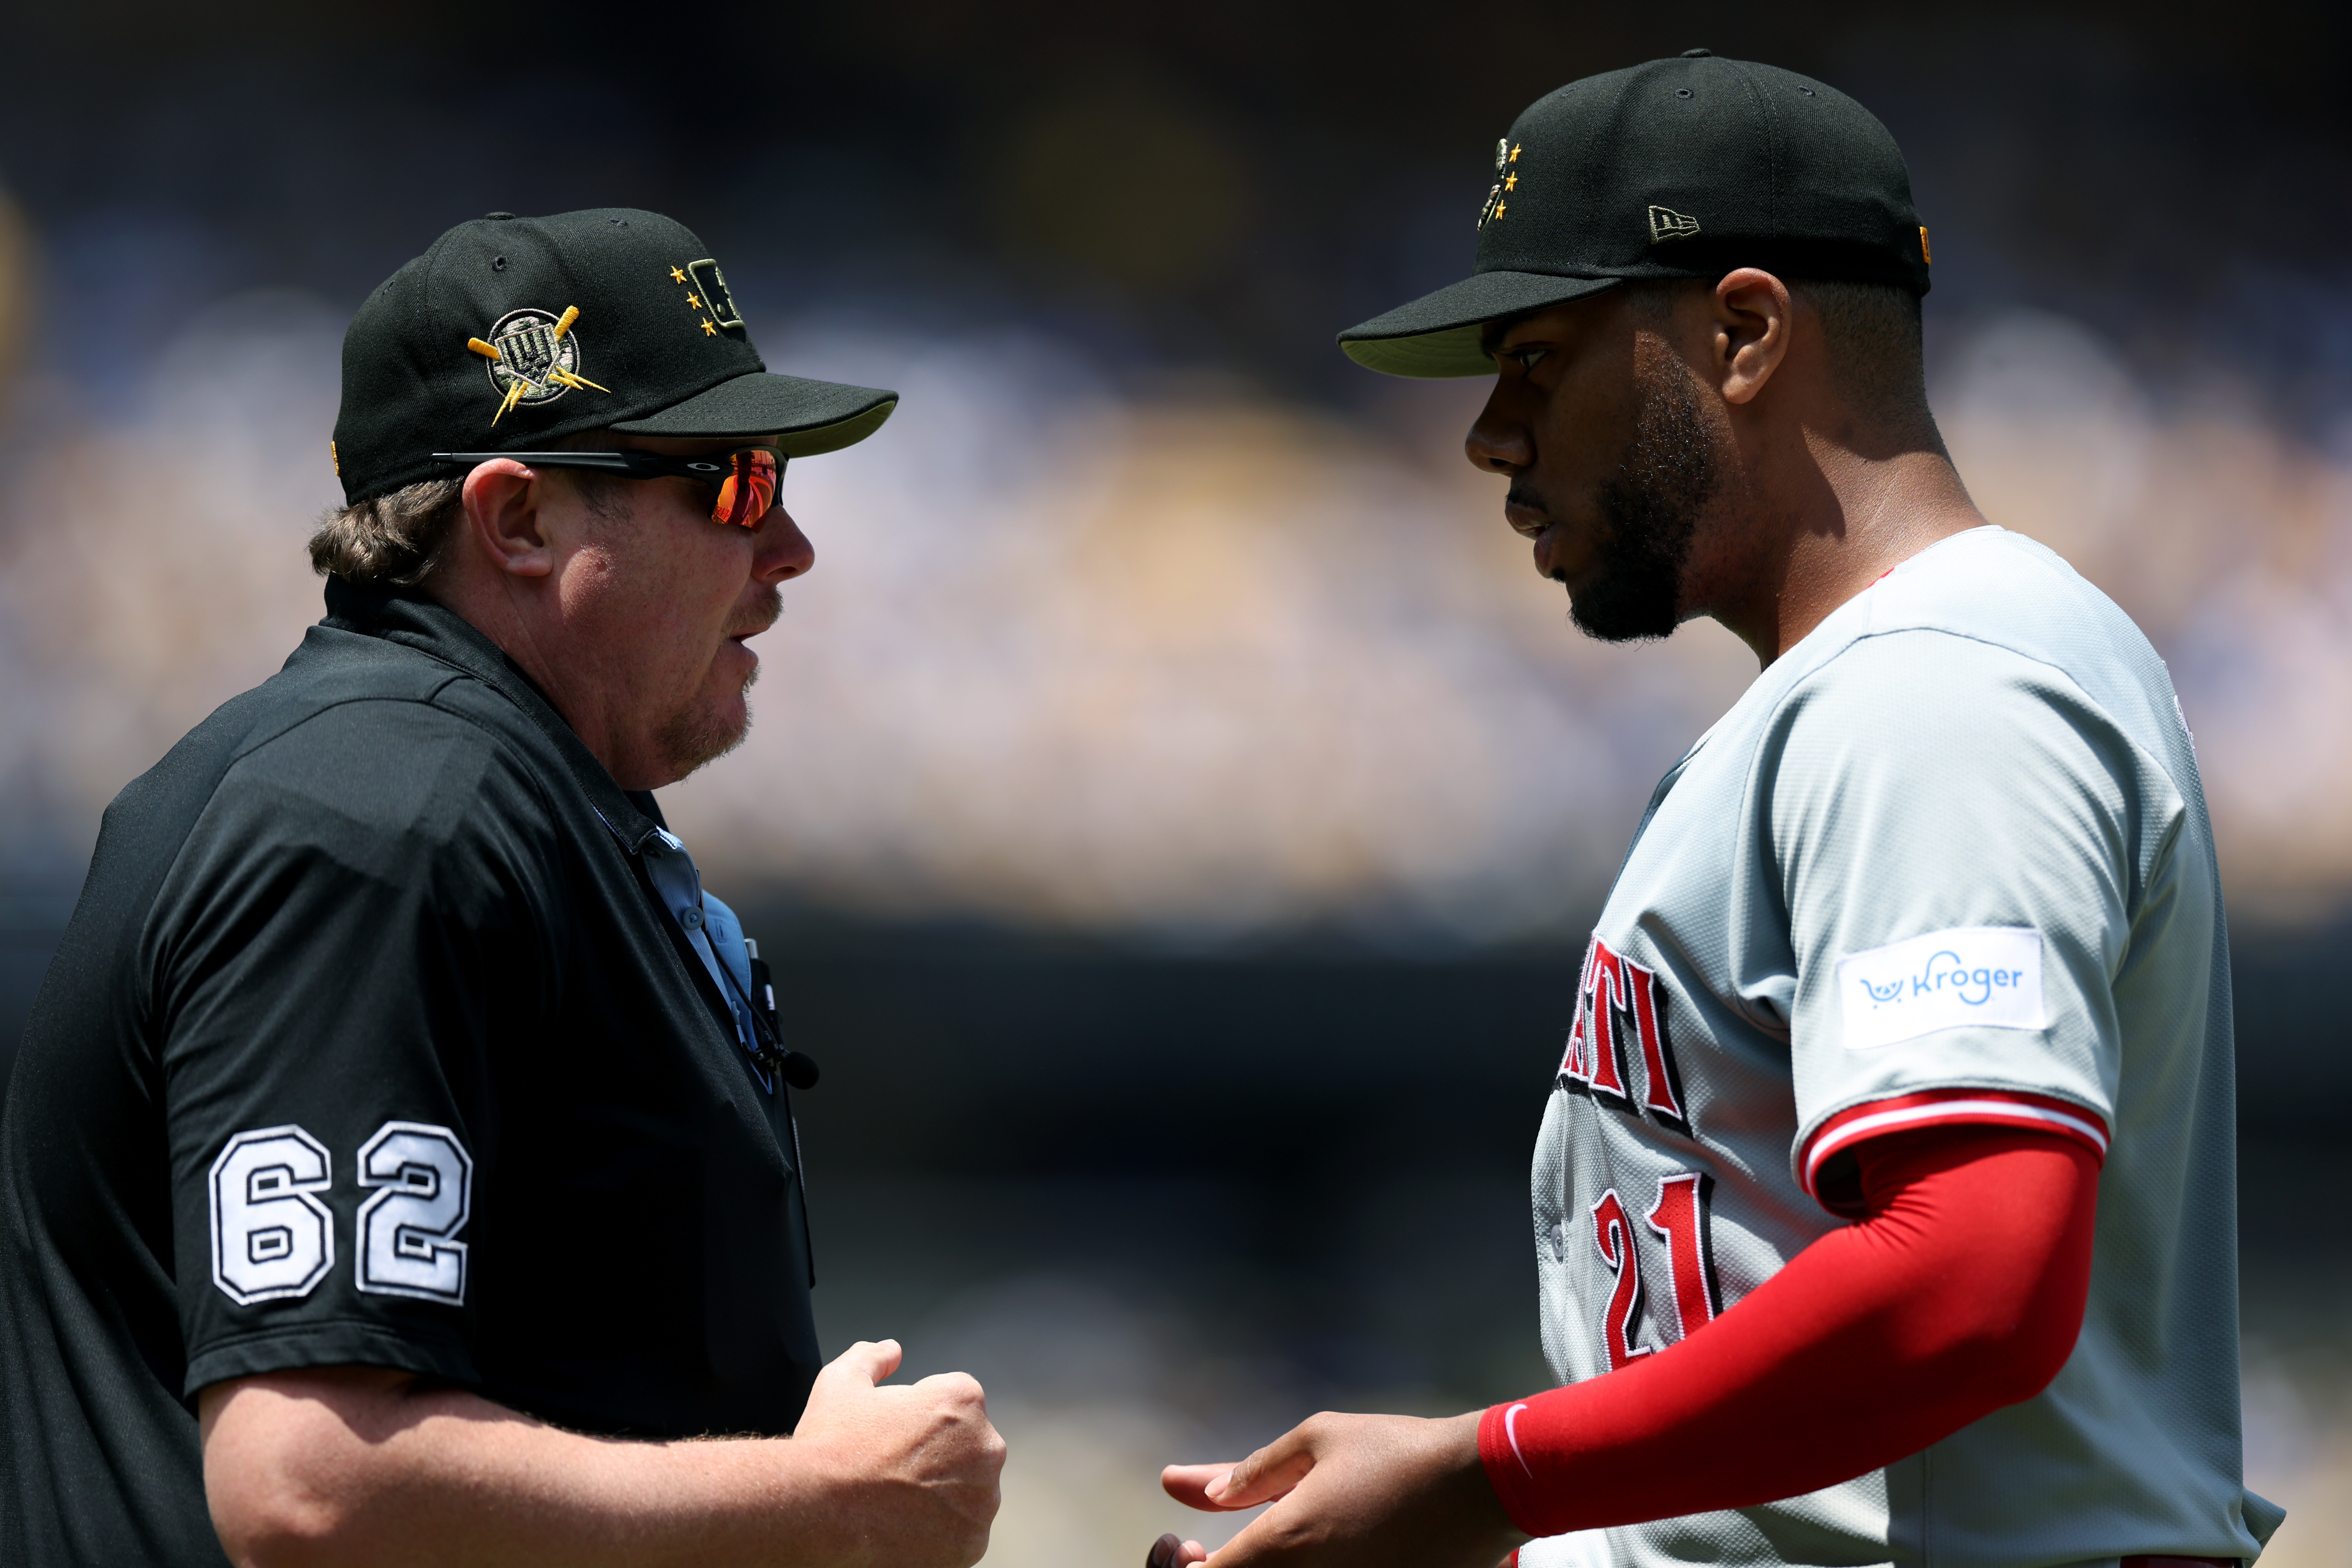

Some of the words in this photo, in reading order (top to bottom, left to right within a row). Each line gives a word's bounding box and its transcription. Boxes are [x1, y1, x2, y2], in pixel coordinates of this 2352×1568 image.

[1913, 951, 2023, 1006] Kroger
[209, 1120, 473, 1306] 62
[1589, 1172, 1722, 1372] 21
